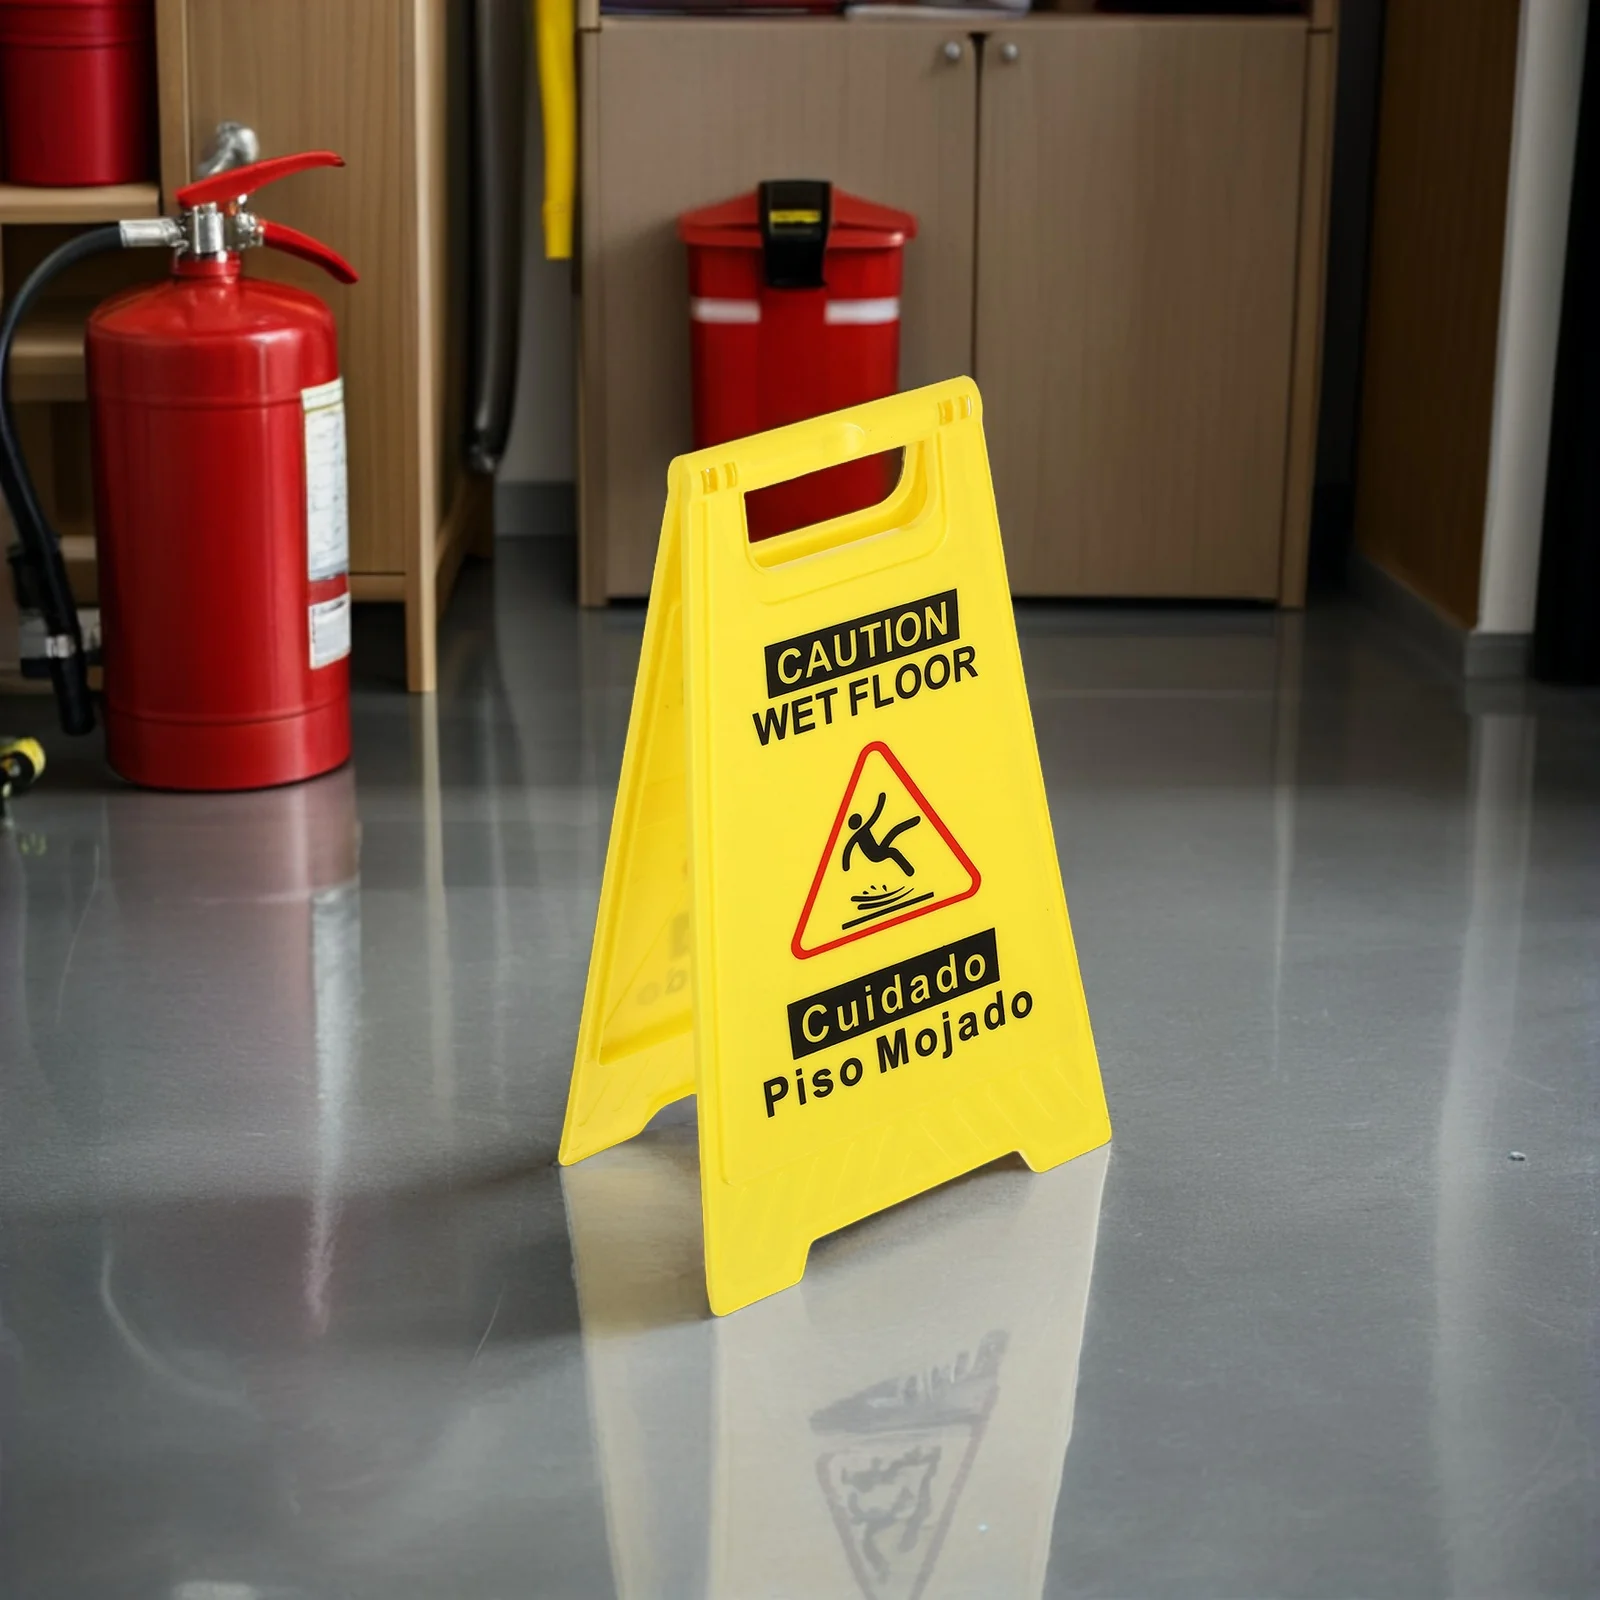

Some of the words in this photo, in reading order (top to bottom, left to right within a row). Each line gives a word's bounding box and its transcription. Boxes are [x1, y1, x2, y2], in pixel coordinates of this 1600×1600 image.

[777, 601, 949, 685] CAUTION
[752, 687, 838, 746] WET
[849, 645, 979, 716] FLOOR
[801, 953, 987, 1044] Cuidado
[763, 1057, 864, 1119] Piso
[876, 990, 1034, 1074] Mojado
